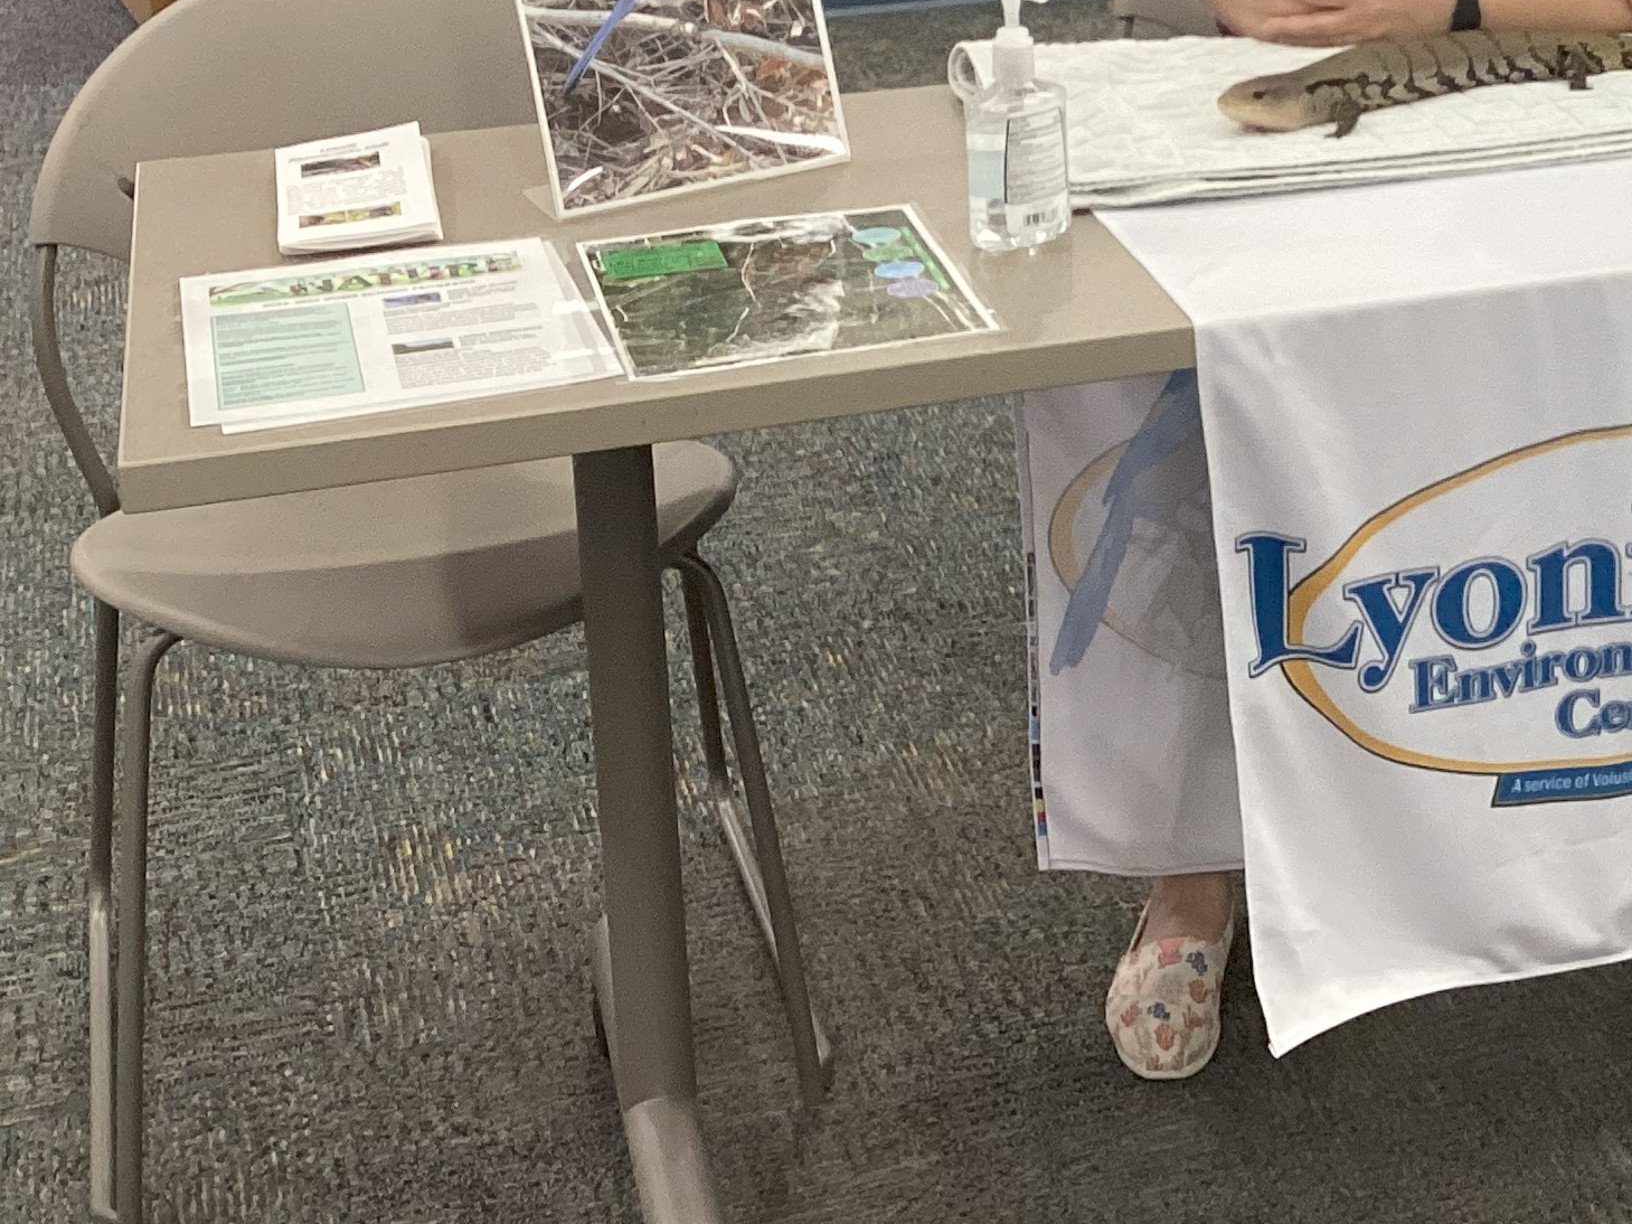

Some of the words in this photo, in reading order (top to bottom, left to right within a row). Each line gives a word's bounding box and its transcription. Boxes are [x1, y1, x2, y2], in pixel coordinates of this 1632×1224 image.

[1511, 778, 1521, 793] A
[1523, 777, 1571, 792] service
[1575, 774, 1590, 788] of
